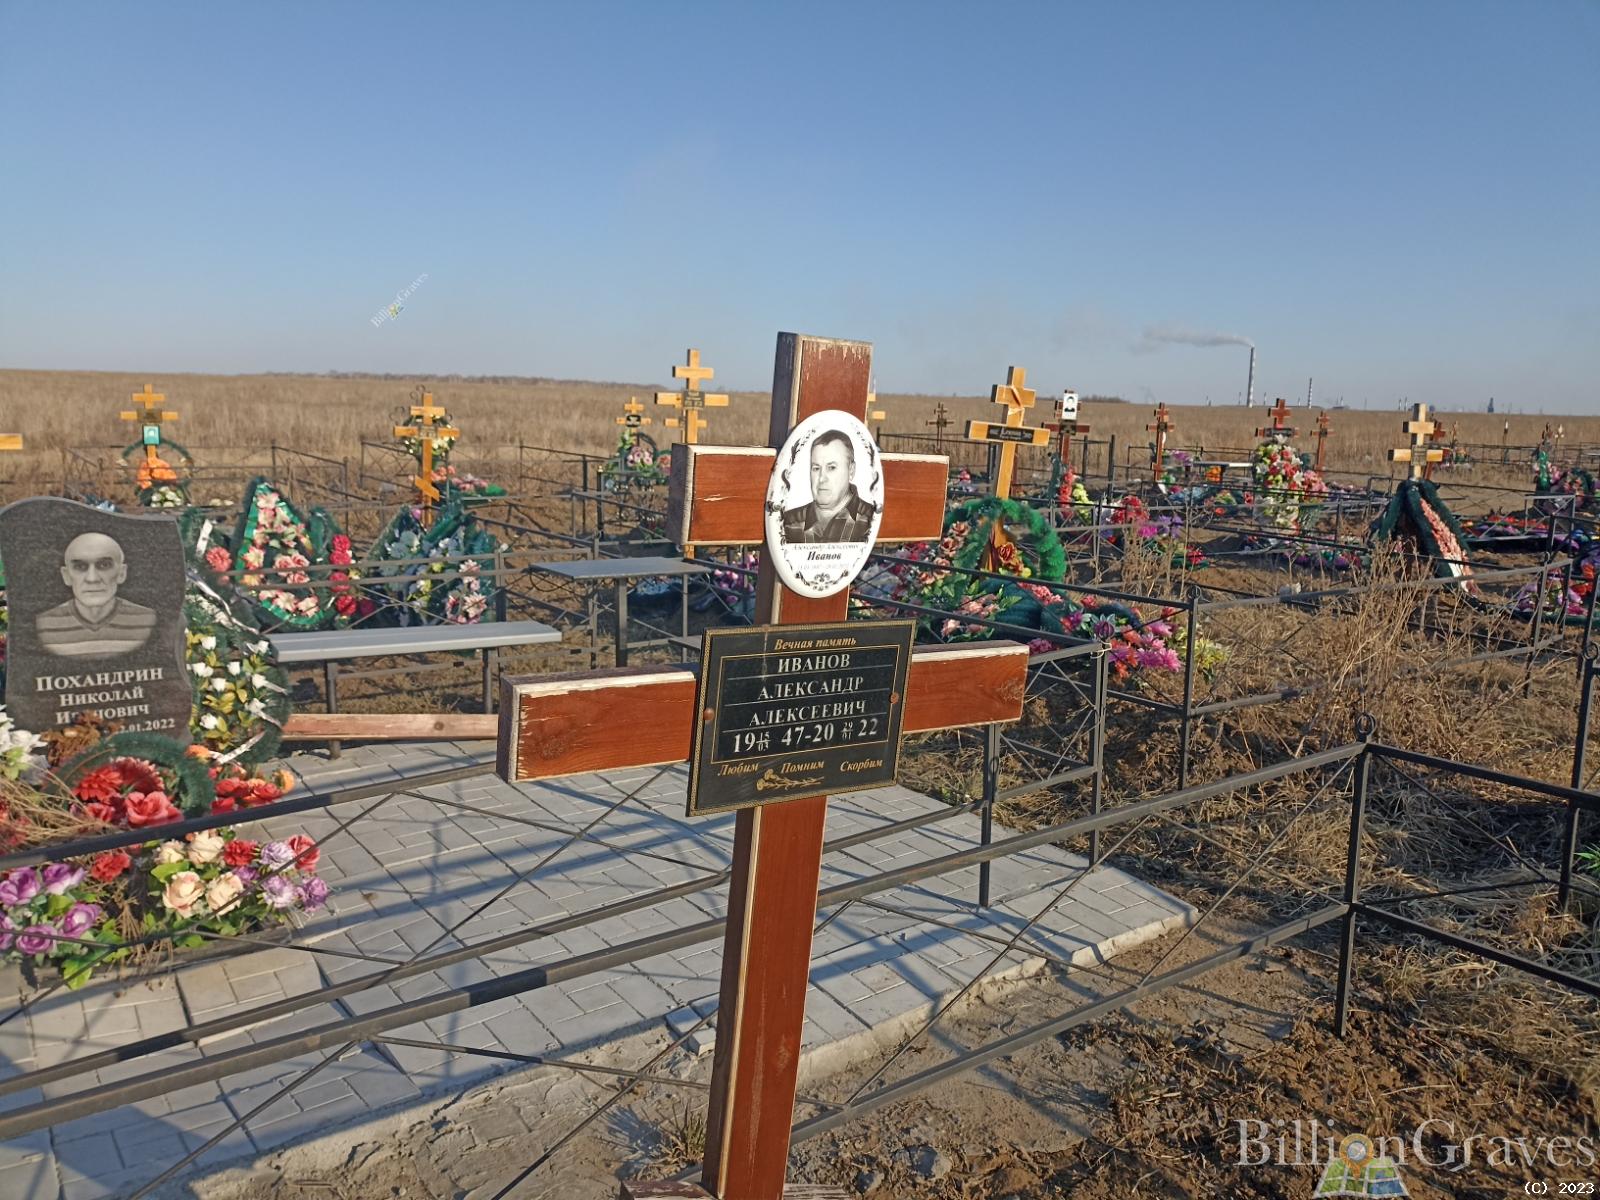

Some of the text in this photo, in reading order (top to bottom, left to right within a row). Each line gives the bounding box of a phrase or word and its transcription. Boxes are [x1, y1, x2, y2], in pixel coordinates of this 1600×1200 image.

[806, 551, 842, 561] Иванов
[774, 637, 857, 650] Вечная память
[777, 653, 851, 673] ИВАНОВ
[35, 667, 163, 691] ПОХАНДРИН
[757, 676, 864, 700] АЛЕКСАНДР
[59, 686, 144, 707] НИКОЛАЙ
[56, 704, 149, 725] ИОВИЧ
[749, 700, 866, 726] АЛЕКСЕЕВИЧ
[717, 758, 883, 776] Любим Помним Скорбим
